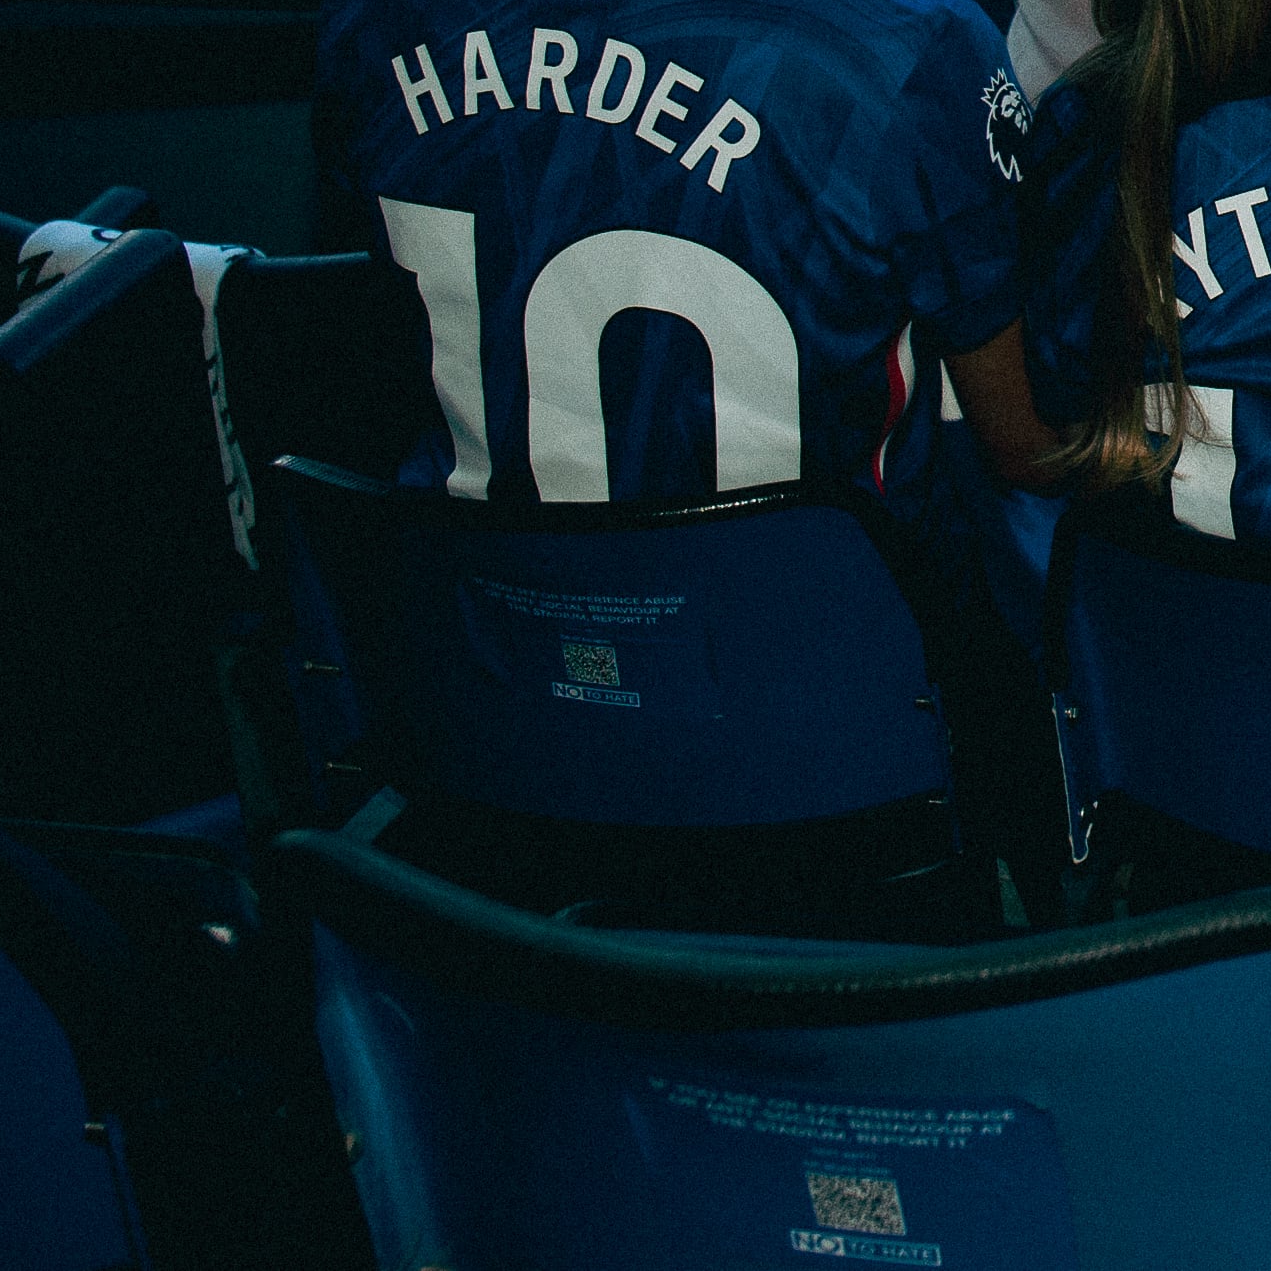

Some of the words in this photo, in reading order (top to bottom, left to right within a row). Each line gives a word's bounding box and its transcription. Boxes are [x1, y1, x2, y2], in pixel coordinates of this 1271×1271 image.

[391, 28, 761, 193] HARDER
[378, 195, 801, 503] 10
[644, 596, 686, 605] ABUSE
[665, 606, 679, 615] AT
[592, 615, 642, 624] REPORT
[554, 683, 582, 700] NO
[586, 690, 601, 701] TO
[605, 692, 636, 705] HATE
[796, 1231, 844, 1256] NO
